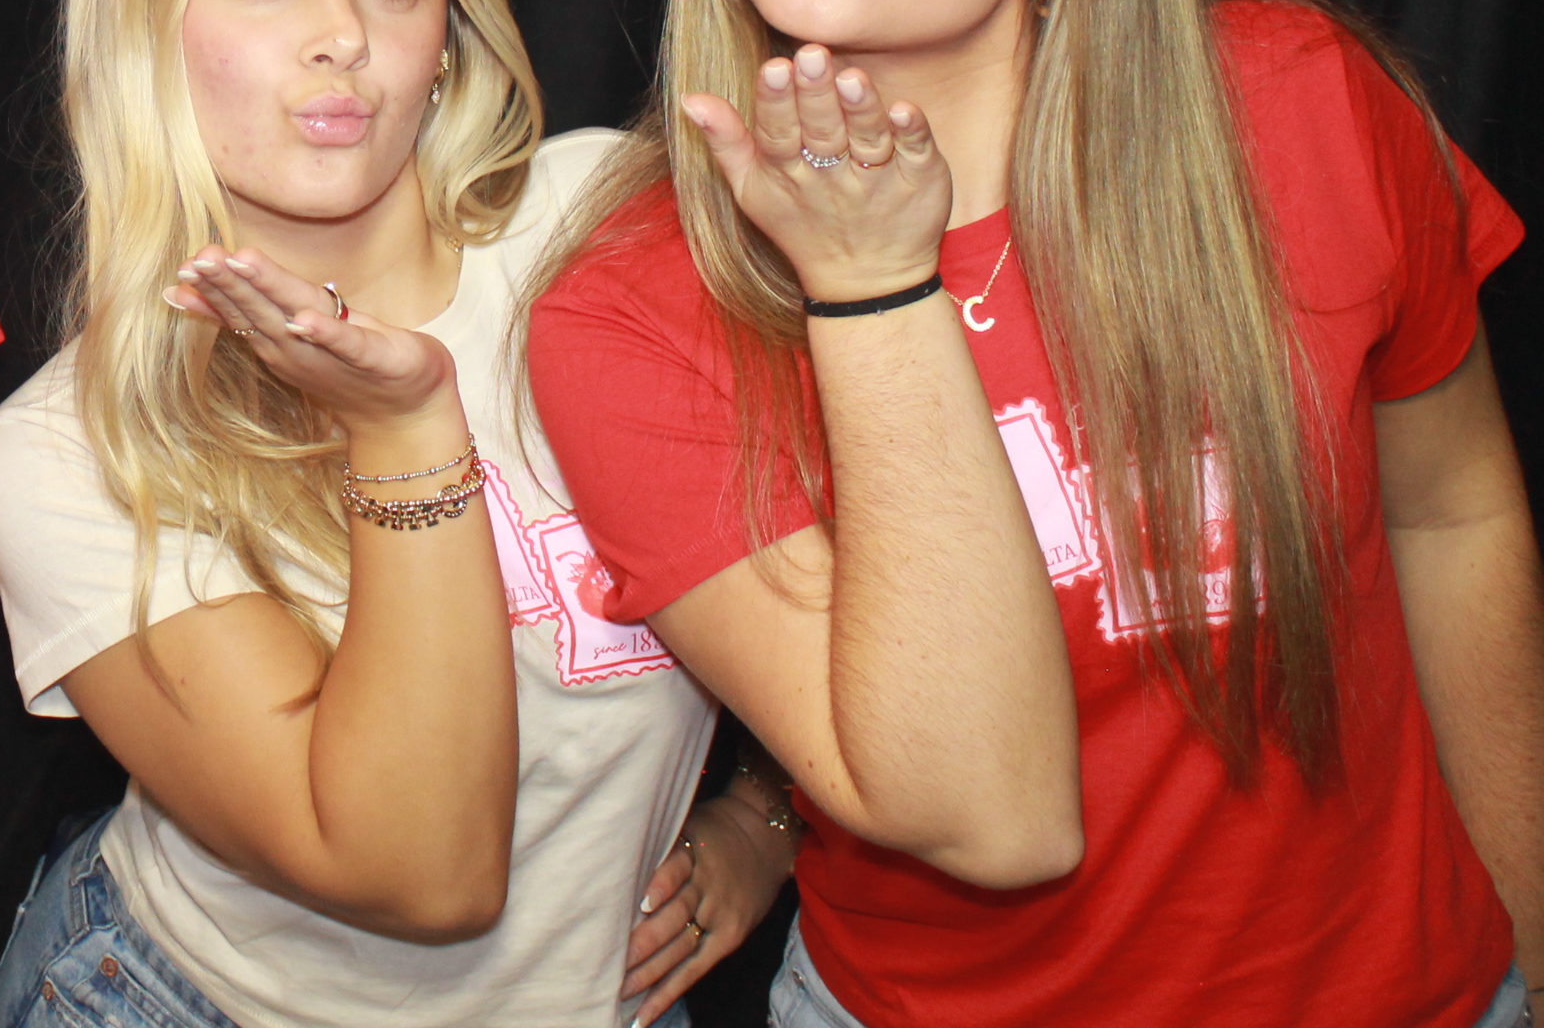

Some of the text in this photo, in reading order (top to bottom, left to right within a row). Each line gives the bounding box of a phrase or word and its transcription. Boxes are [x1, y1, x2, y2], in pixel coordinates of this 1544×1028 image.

[509, 585, 541, 603] LTA
[593, 629, 665, 660] since 18
